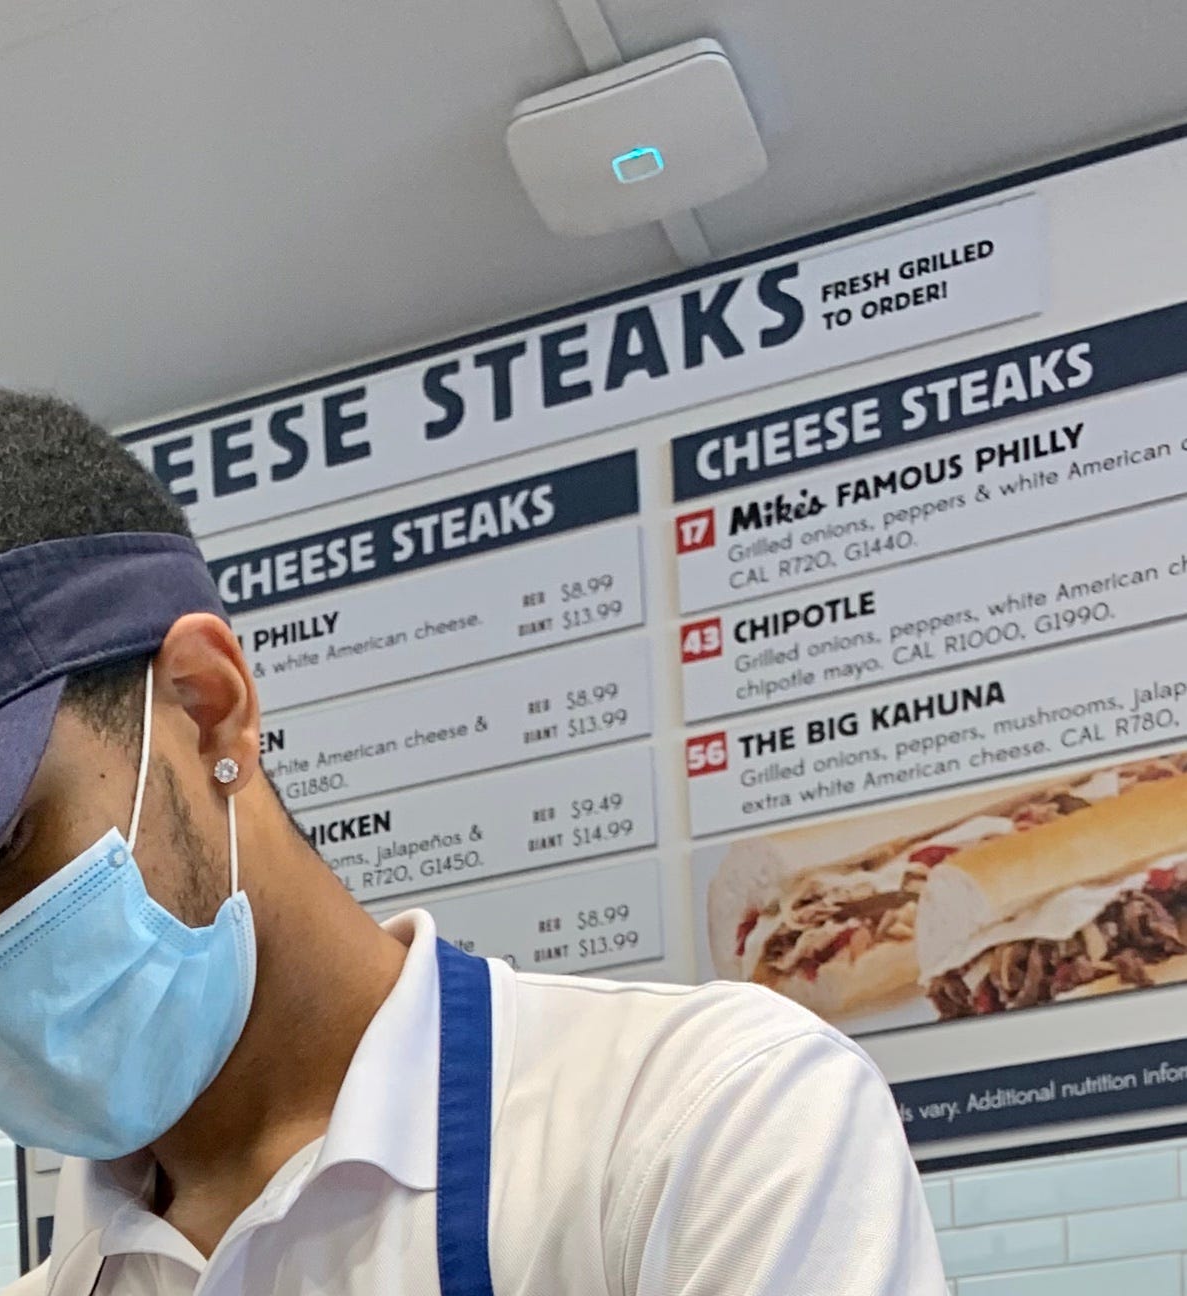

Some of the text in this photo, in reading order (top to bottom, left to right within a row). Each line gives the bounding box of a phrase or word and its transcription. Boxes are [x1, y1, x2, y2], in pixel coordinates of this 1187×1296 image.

[822, 240, 993, 302] FRESH GRILLED
[822, 281, 946, 329] TO ORDER!
[422, 262, 804, 441] STEAKS
[697, 346, 1092, 478] CHEESE STEAKS
[728, 444, 1170, 562] Grilled onions, peppers & white American
[729, 489, 826, 534] Mike's
[837, 454, 962, 507] FAMOUS
[976, 422, 1083, 472] PHILLY
[218, 486, 554, 602] CHEESE STEAKS
[561, 575, 613, 602] $8.99
[254, 611, 338, 652] PHILLY
[562, 600, 623, 631] $13.99
[734, 591, 875, 643] CHIPOTLE
[252, 614, 480, 678] & white American cheese.
[736, 603, 1114, 699] chipotle mayo. CAL R1000, G1990.
[567, 683, 618, 710] $8.99
[738, 726, 795, 758] THE
[807, 712, 858, 744] BIG
[871, 681, 1004, 730] KAHUNA
[567, 709, 628, 738] $13.99
[740, 758, 805, 787] Grilled
[813, 748, 887, 772] onions,
[895, 727, 985, 759] peppers,
[993, 697, 1124, 733] mushrooms,
[742, 709, 1179, 814] extra white American cheese. CAL R780,
[571, 793, 623, 820] $9.49
[572, 819, 633, 847] $14.99
[577, 904, 629, 930] $8.99
[578, 930, 638, 959] $13.99
[919, 1074, 1136, 1121] vary. Additional nutrition
